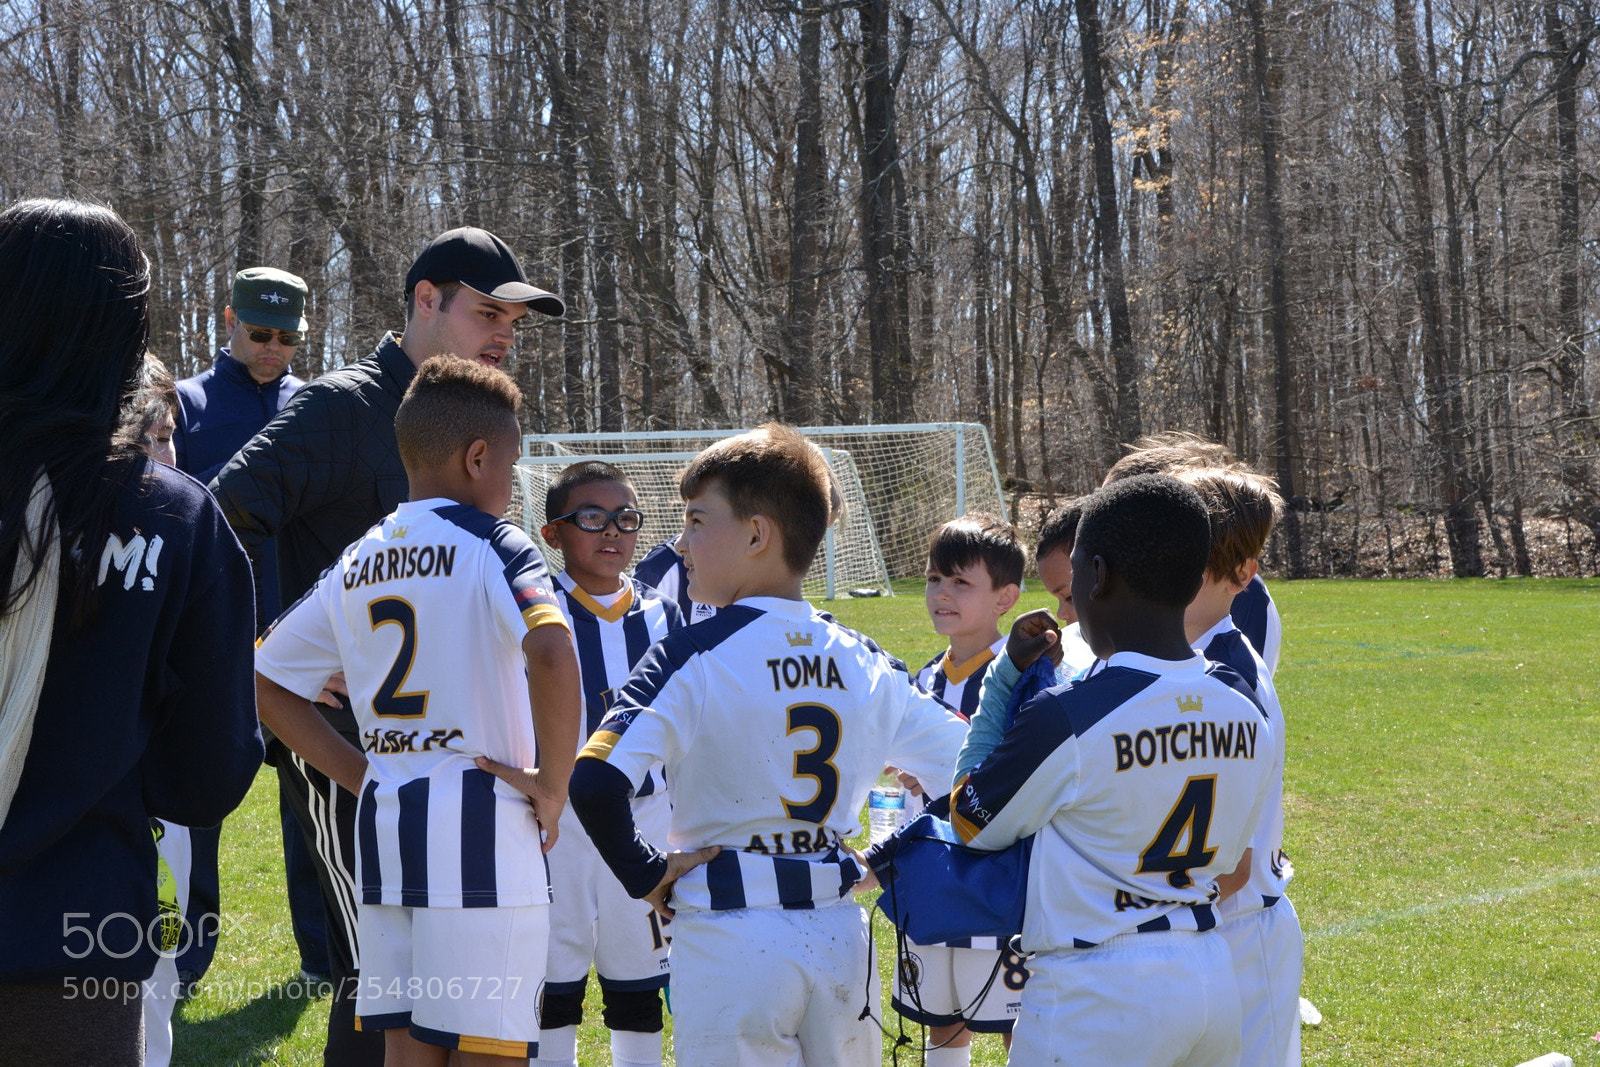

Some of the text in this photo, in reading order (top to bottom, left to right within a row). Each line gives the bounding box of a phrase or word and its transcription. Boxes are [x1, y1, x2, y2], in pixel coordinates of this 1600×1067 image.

[70, 531, 164, 592] M!
[343, 545, 457, 591] GARRISON
[367, 595, 430, 719] 2
[766, 654, 848, 692] TOMA
[779, 702, 843, 826] 3
[1112, 721, 1258, 773] BOTCHWAY
[1134, 774, 1219, 889] 4
